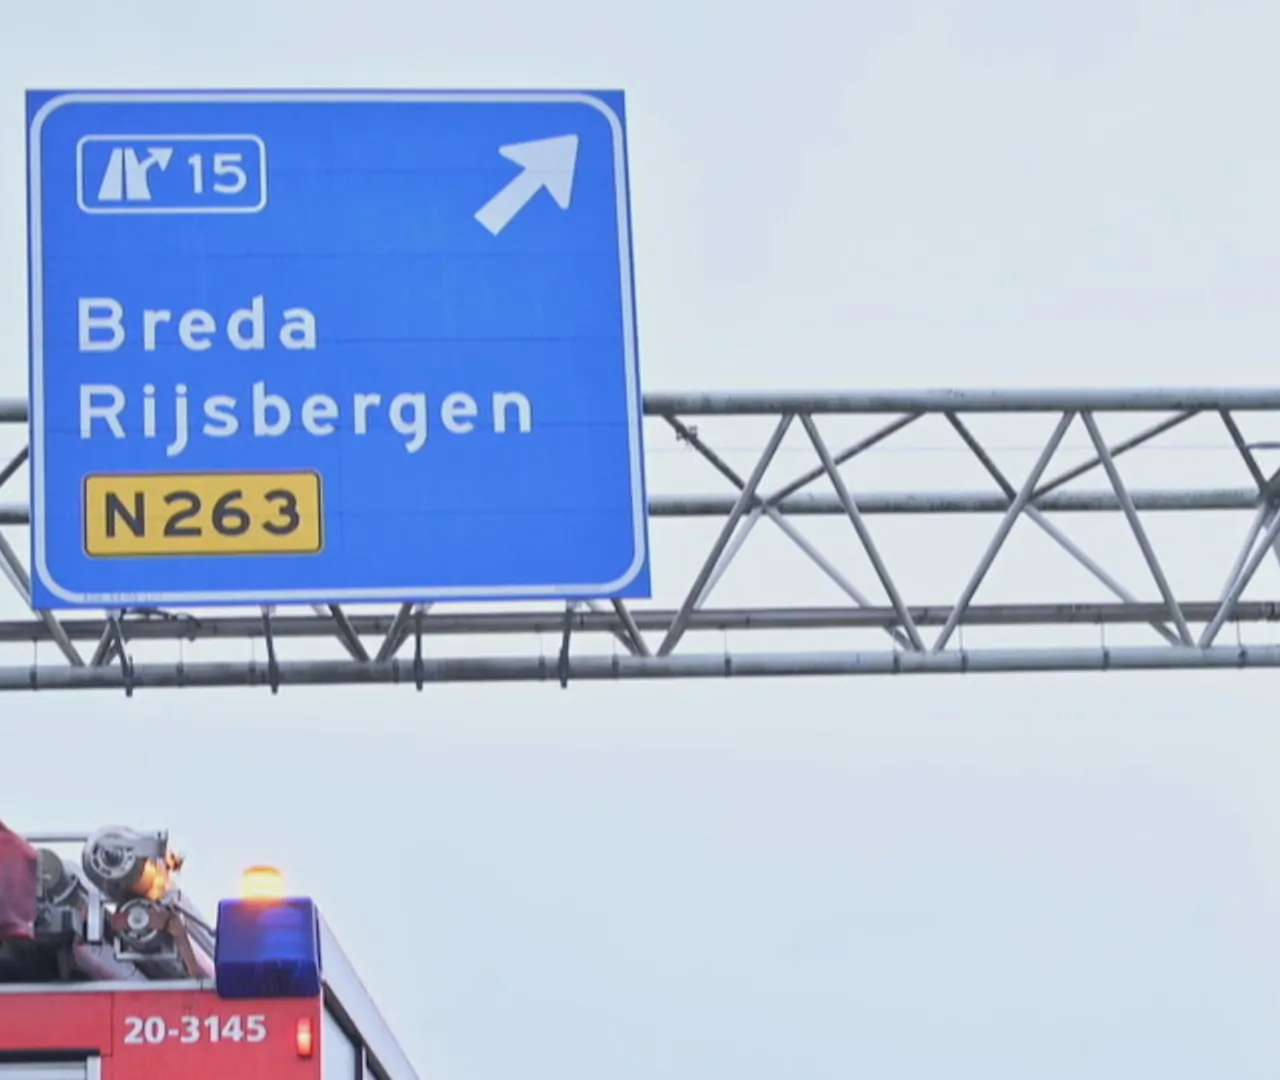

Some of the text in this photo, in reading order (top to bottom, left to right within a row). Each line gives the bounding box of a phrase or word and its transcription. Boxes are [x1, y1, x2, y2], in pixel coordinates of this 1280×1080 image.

[187, 152, 248, 195] 15
[78, 294, 317, 353] Breda
[78, 381, 532, 457] Rijsbergen
[104, 488, 300, 538] N263
[123, 1014, 267, 1044] 20-3145
